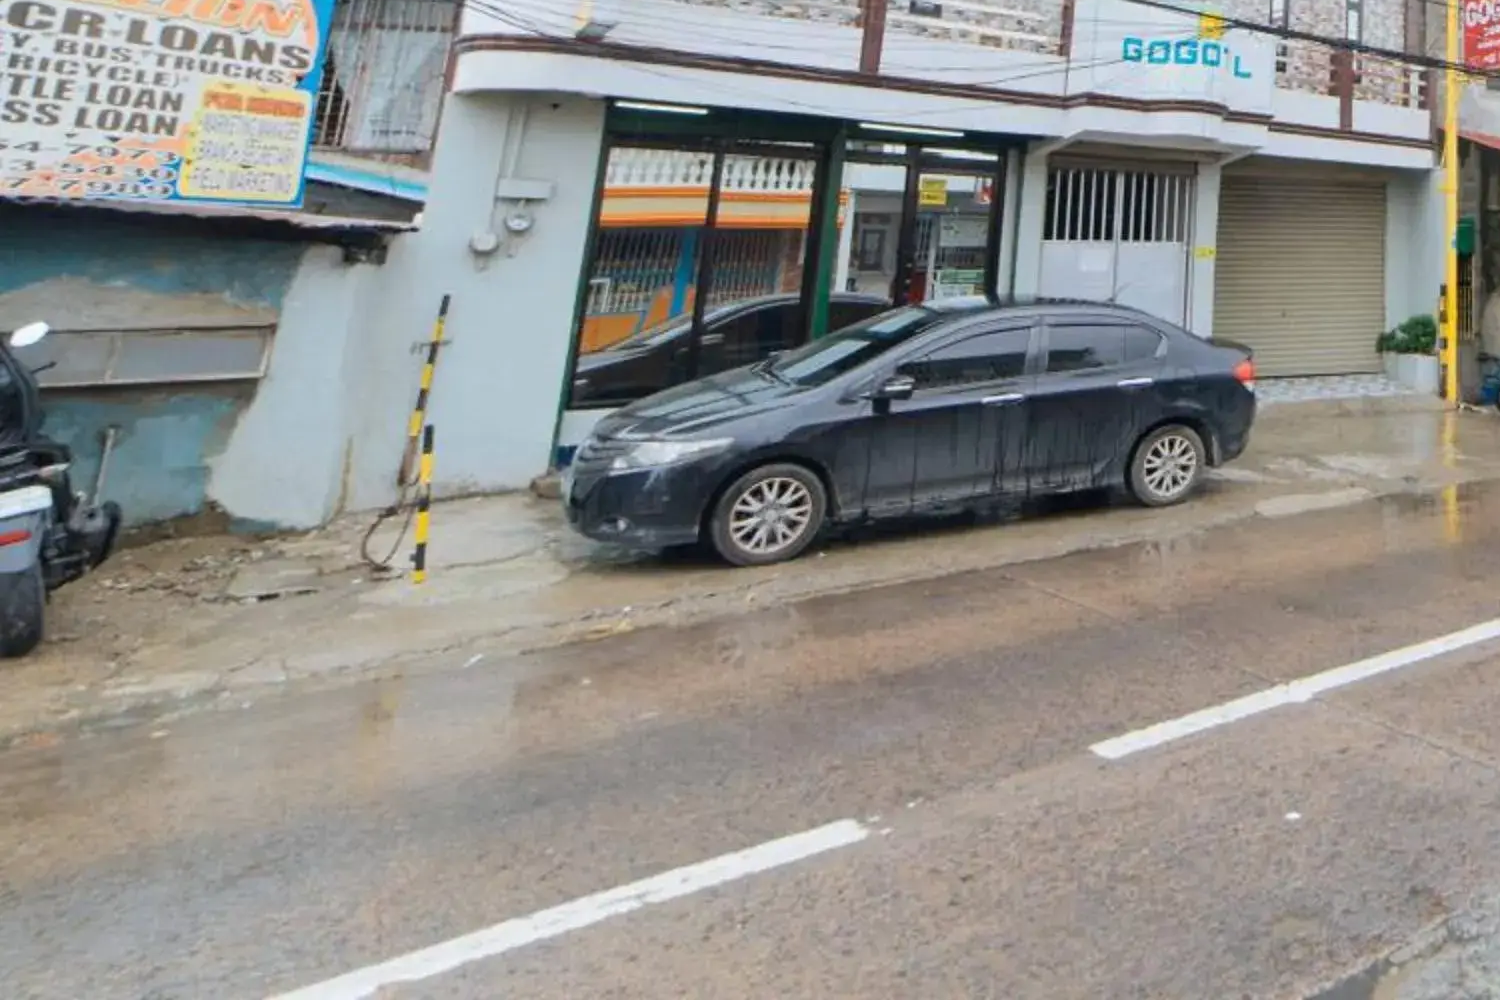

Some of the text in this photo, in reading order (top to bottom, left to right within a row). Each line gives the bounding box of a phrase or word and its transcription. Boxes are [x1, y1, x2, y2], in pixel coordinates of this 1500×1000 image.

[126, 19, 312, 70] LOANS
[85, 82, 183, 113] LOAN
[74, 107, 179, 137] LOAN
